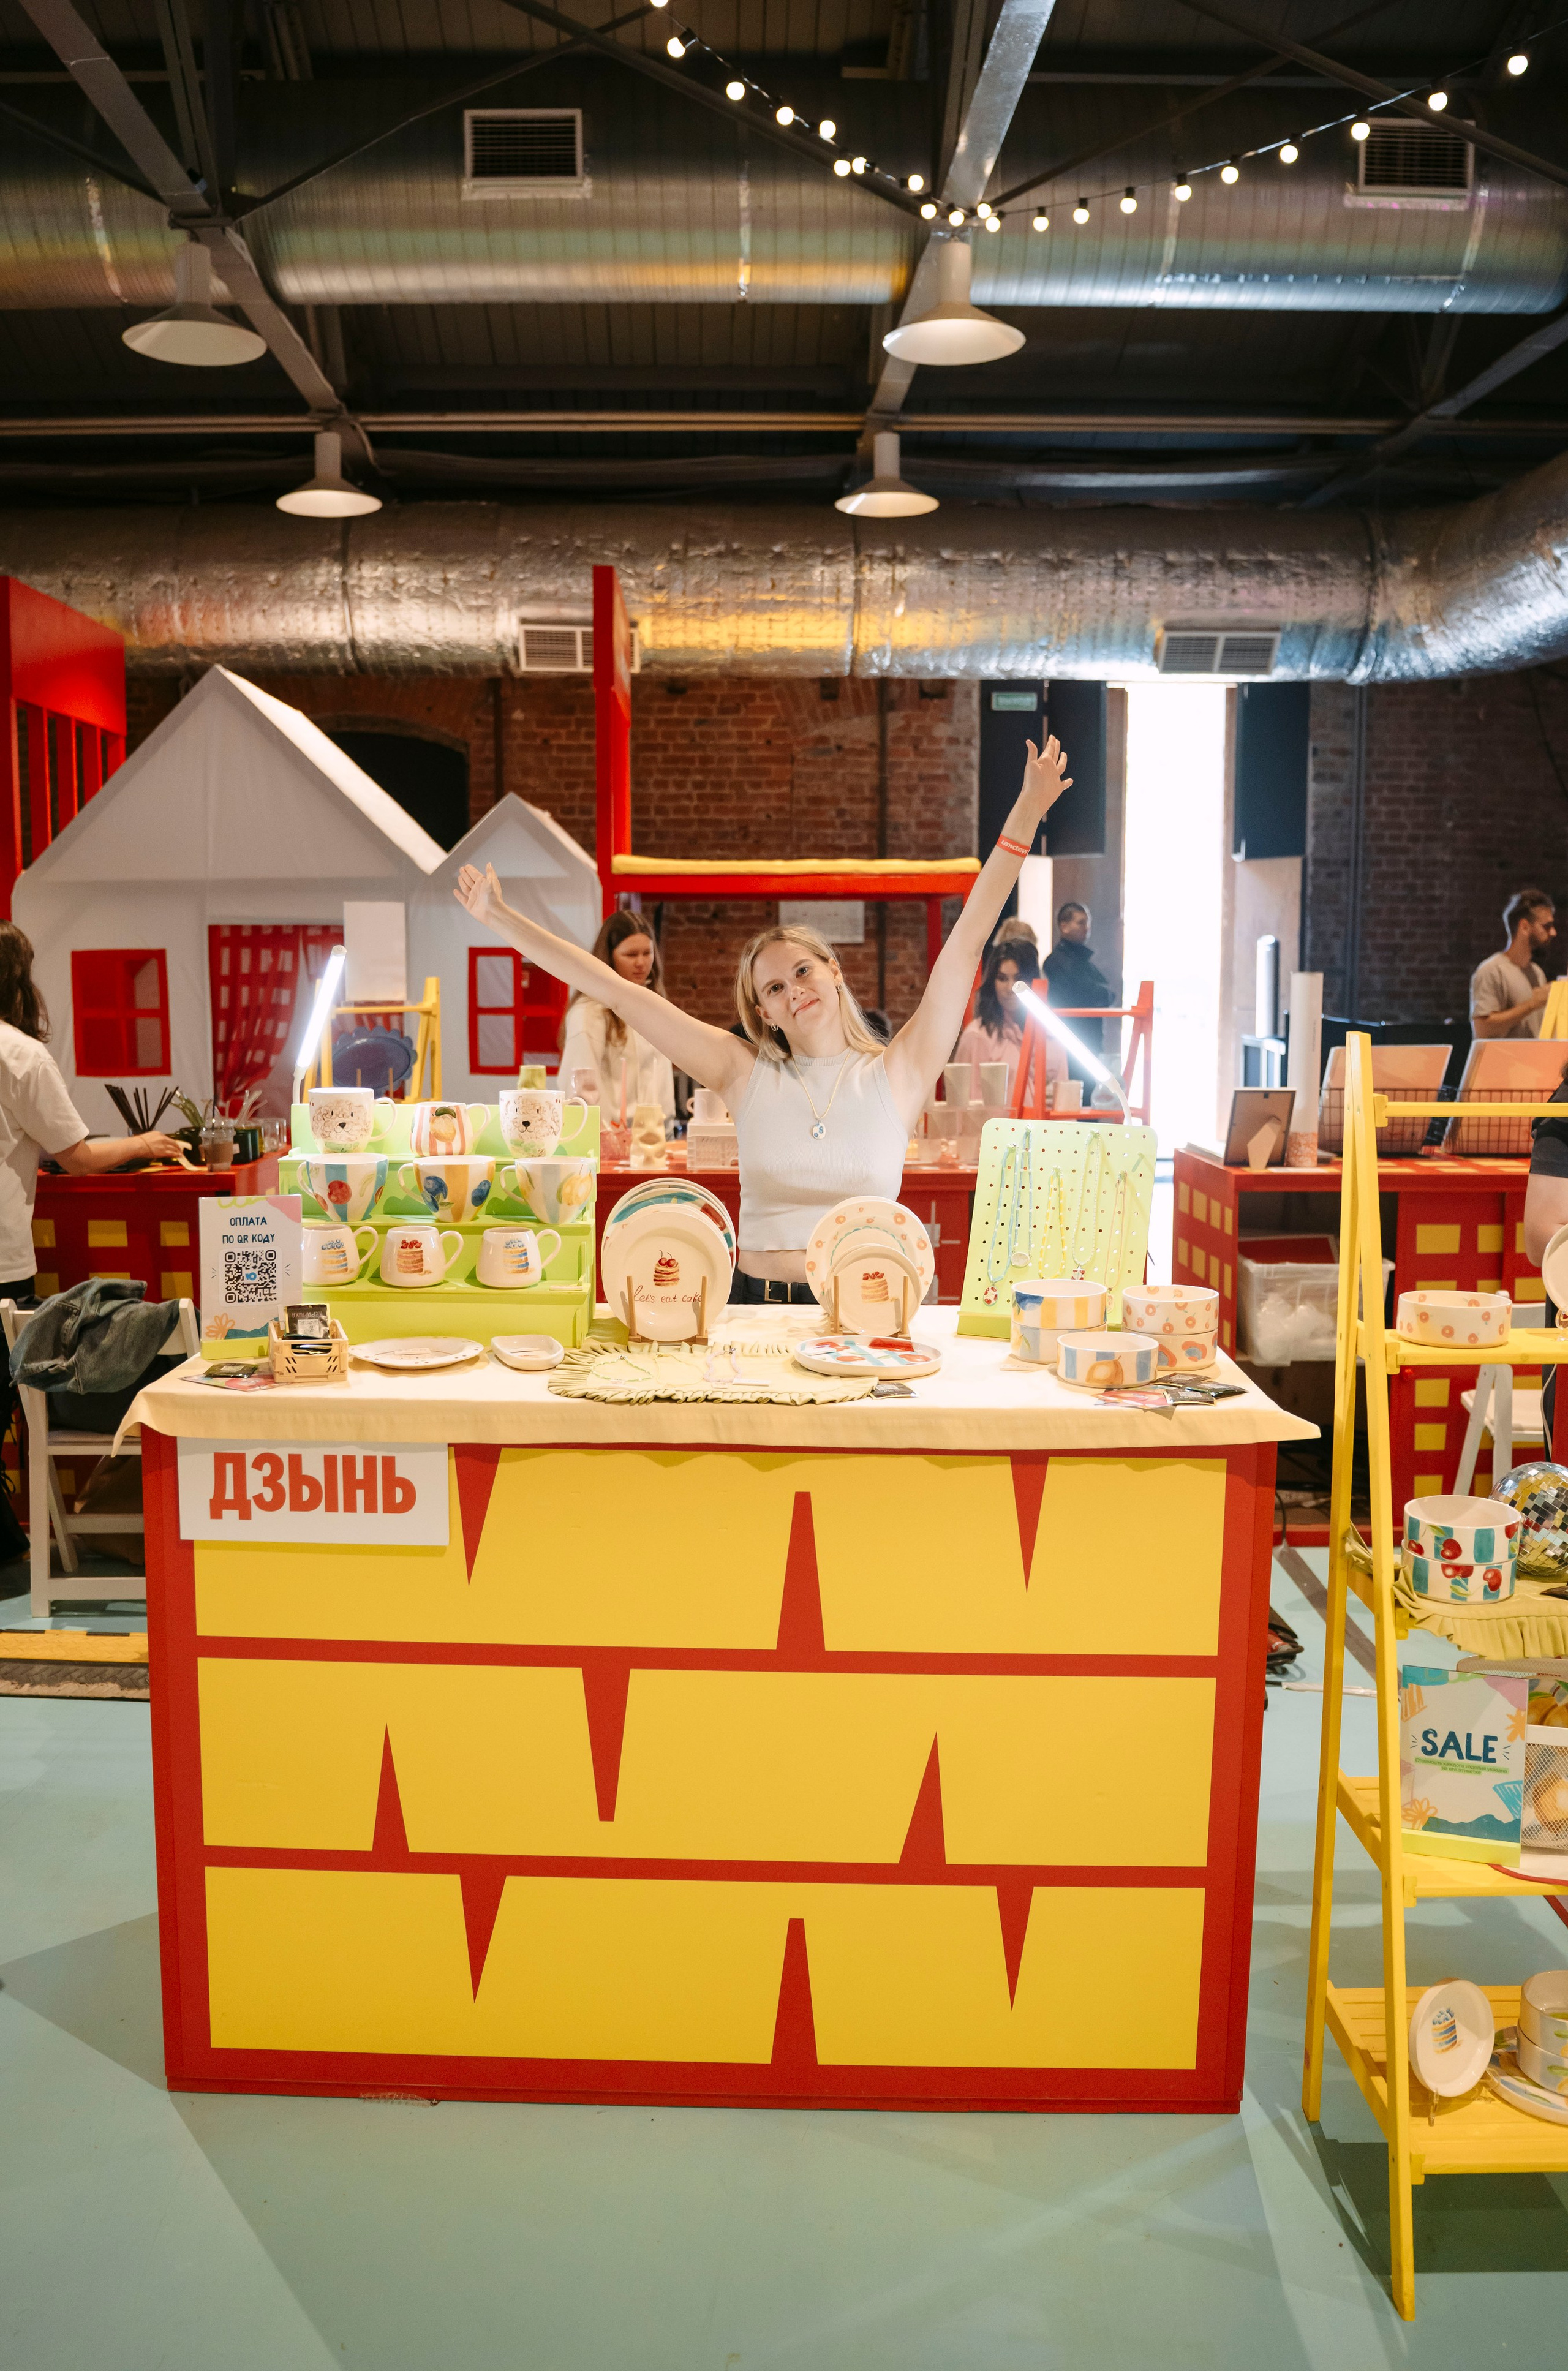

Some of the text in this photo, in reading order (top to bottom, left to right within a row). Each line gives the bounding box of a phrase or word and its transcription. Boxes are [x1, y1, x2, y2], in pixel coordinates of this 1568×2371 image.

[1000, 840, 1028, 854] Маркет
[230, 1216, 268, 1226] ОПЛАТА
[222, 1234, 275, 1244] ПО QR КОДУ
[661, 1294, 677, 1303] eat
[682, 1292, 702, 1303] cake
[209, 1452, 417, 1520] ДЗЫНЬ
[1421, 1728, 1498, 1763] SALE
